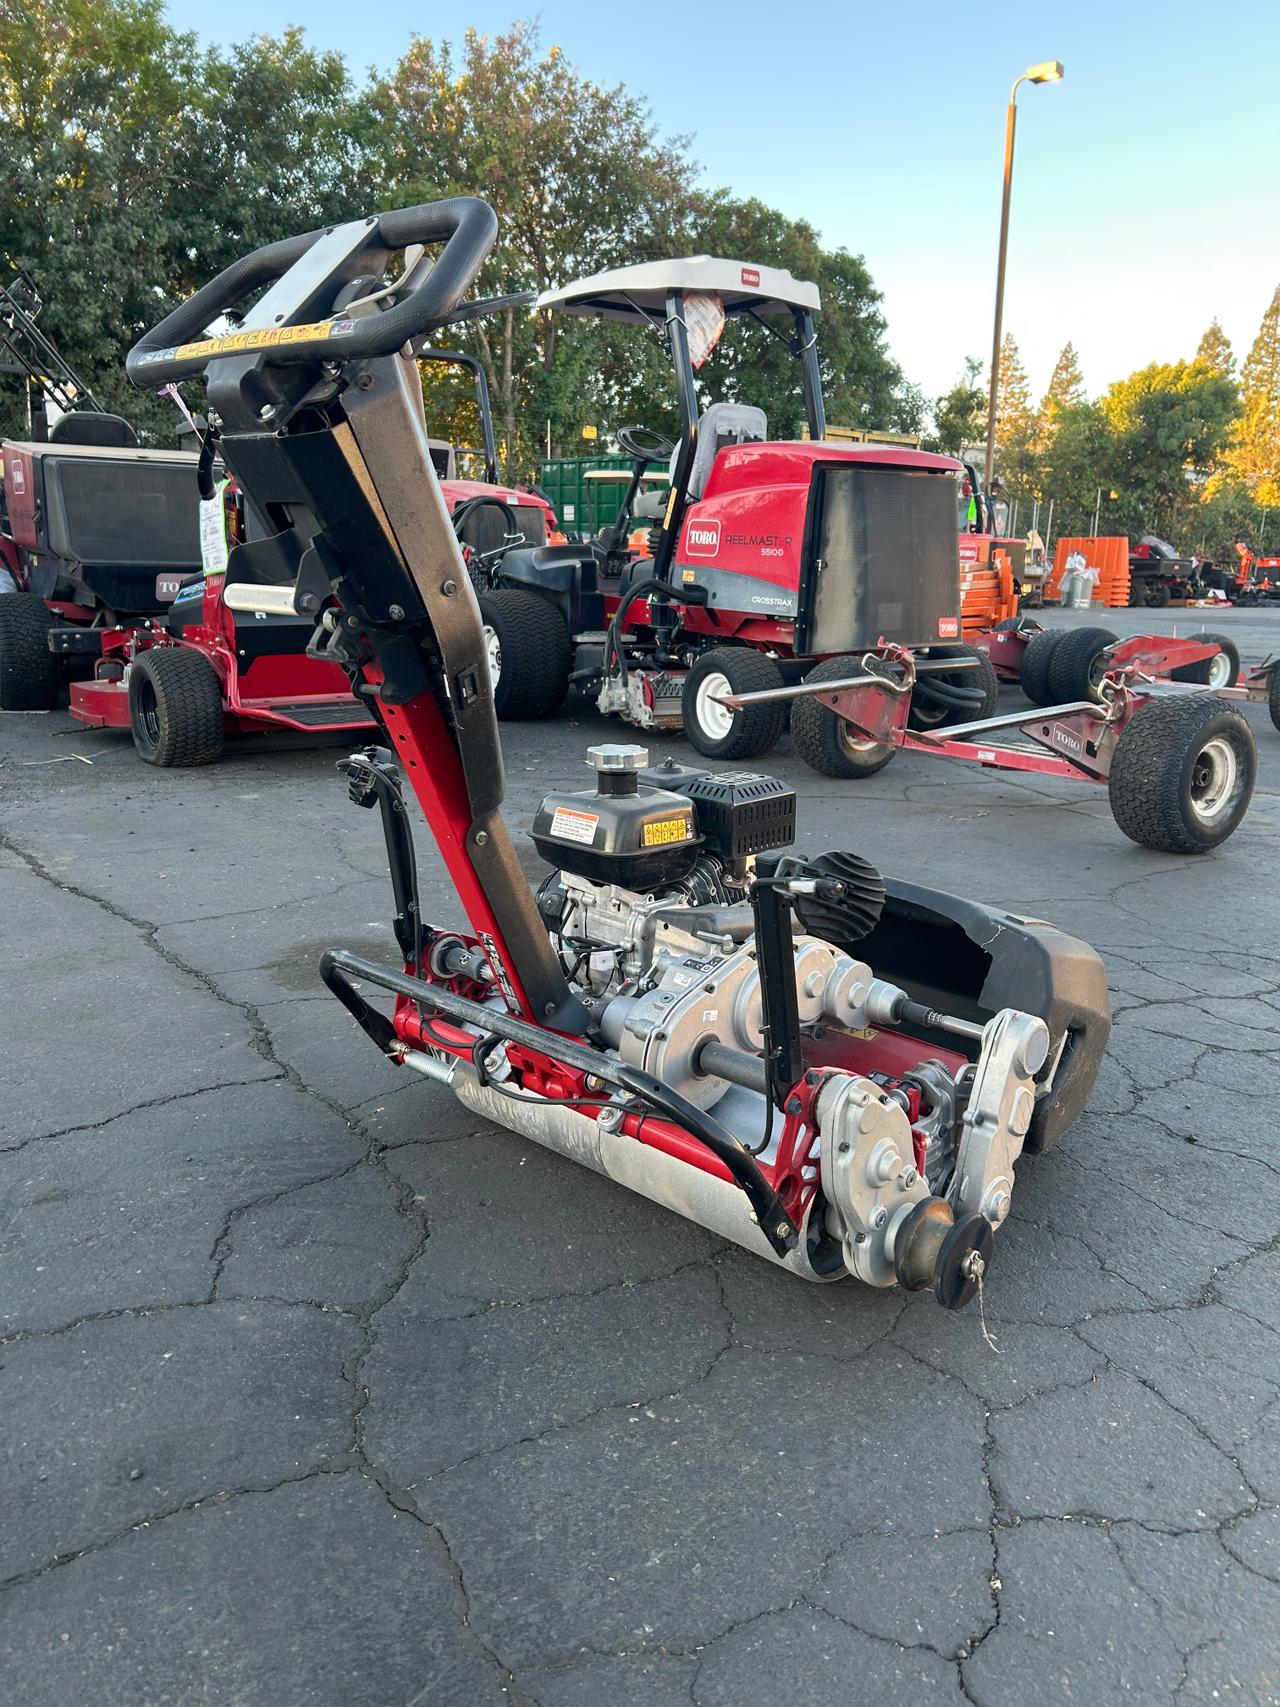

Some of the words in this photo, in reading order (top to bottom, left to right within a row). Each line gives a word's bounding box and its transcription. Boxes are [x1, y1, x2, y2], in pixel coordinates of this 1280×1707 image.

[690, 529, 717, 545] TORO
[725, 534, 793, 547] REELMASTR
[159, 581, 180, 593] TO
[751, 596, 793, 608] CROSSTRAX
[940, 623, 957, 633] TORO
[1056, 729, 1080, 752] TORO
